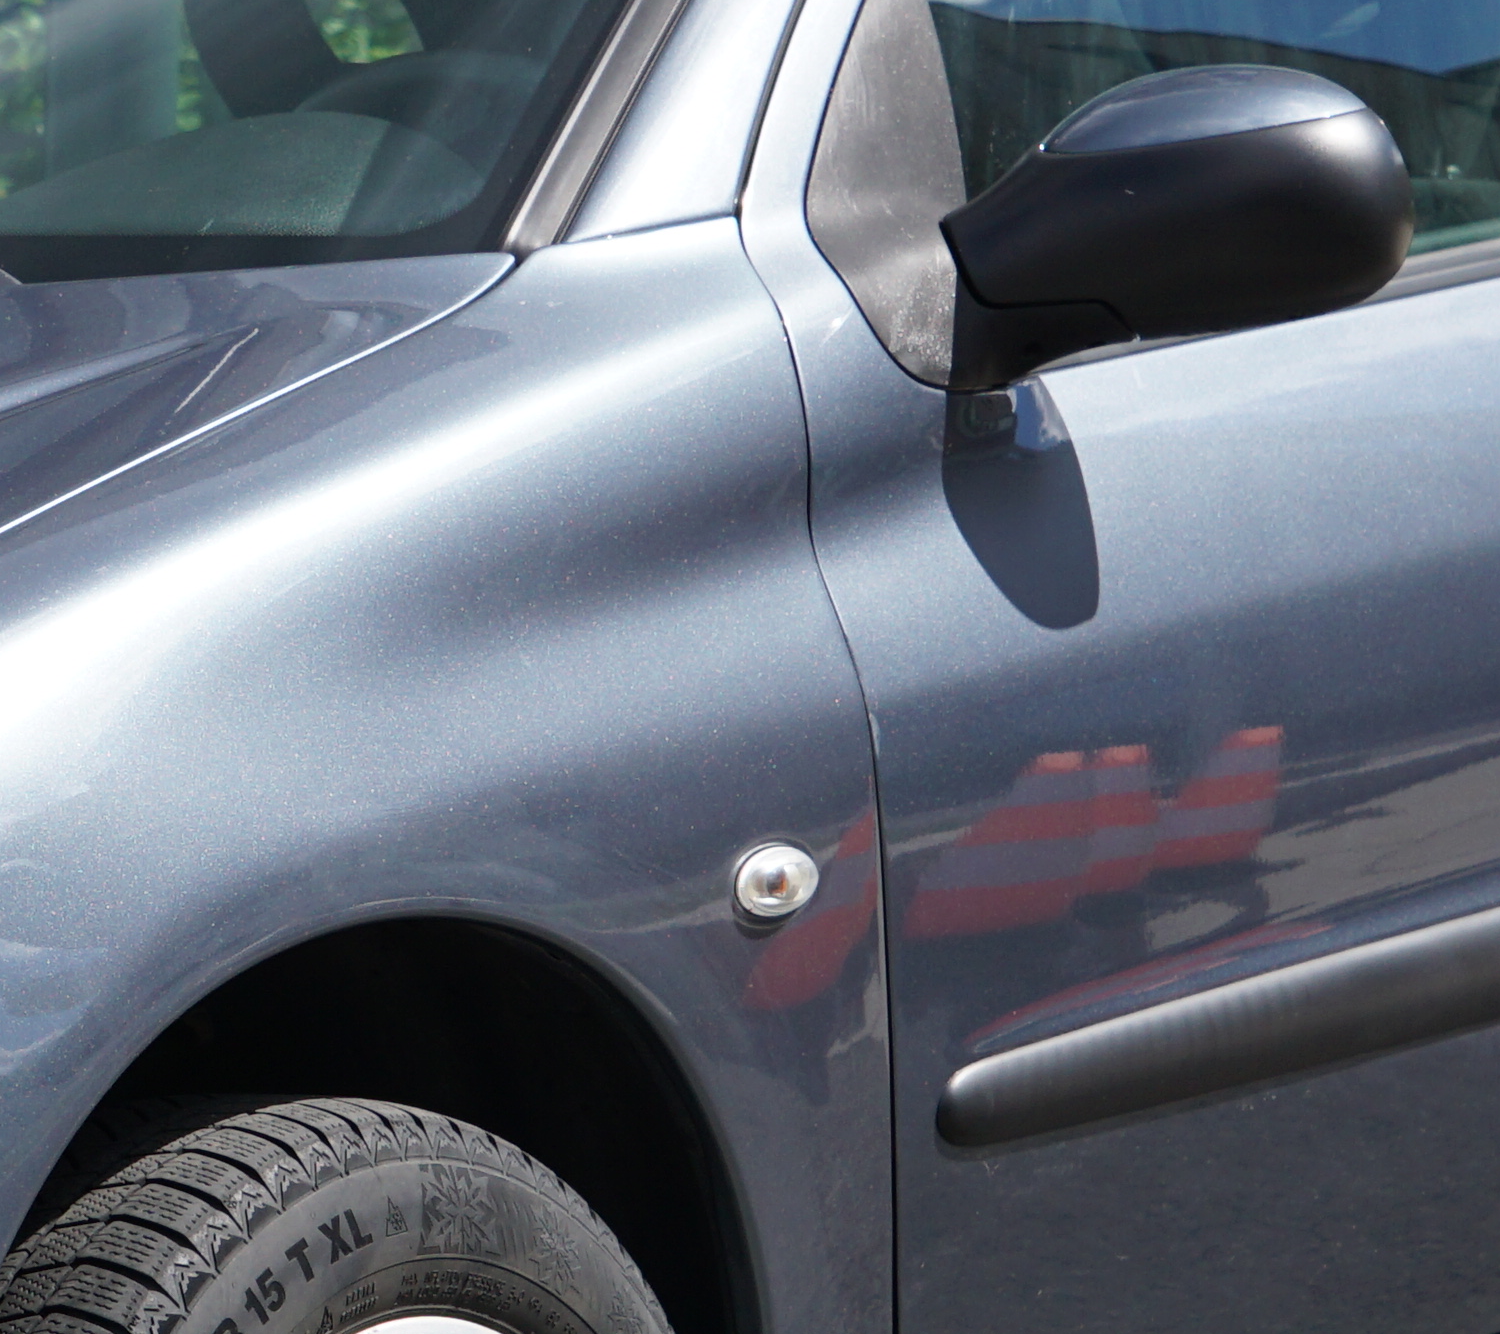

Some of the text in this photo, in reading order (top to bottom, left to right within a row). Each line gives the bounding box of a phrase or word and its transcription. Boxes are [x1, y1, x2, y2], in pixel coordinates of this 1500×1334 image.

[244, 1267, 286, 1325] 15
[285, 1237, 315, 1283] T
[317, 1208, 373, 1264] XL
